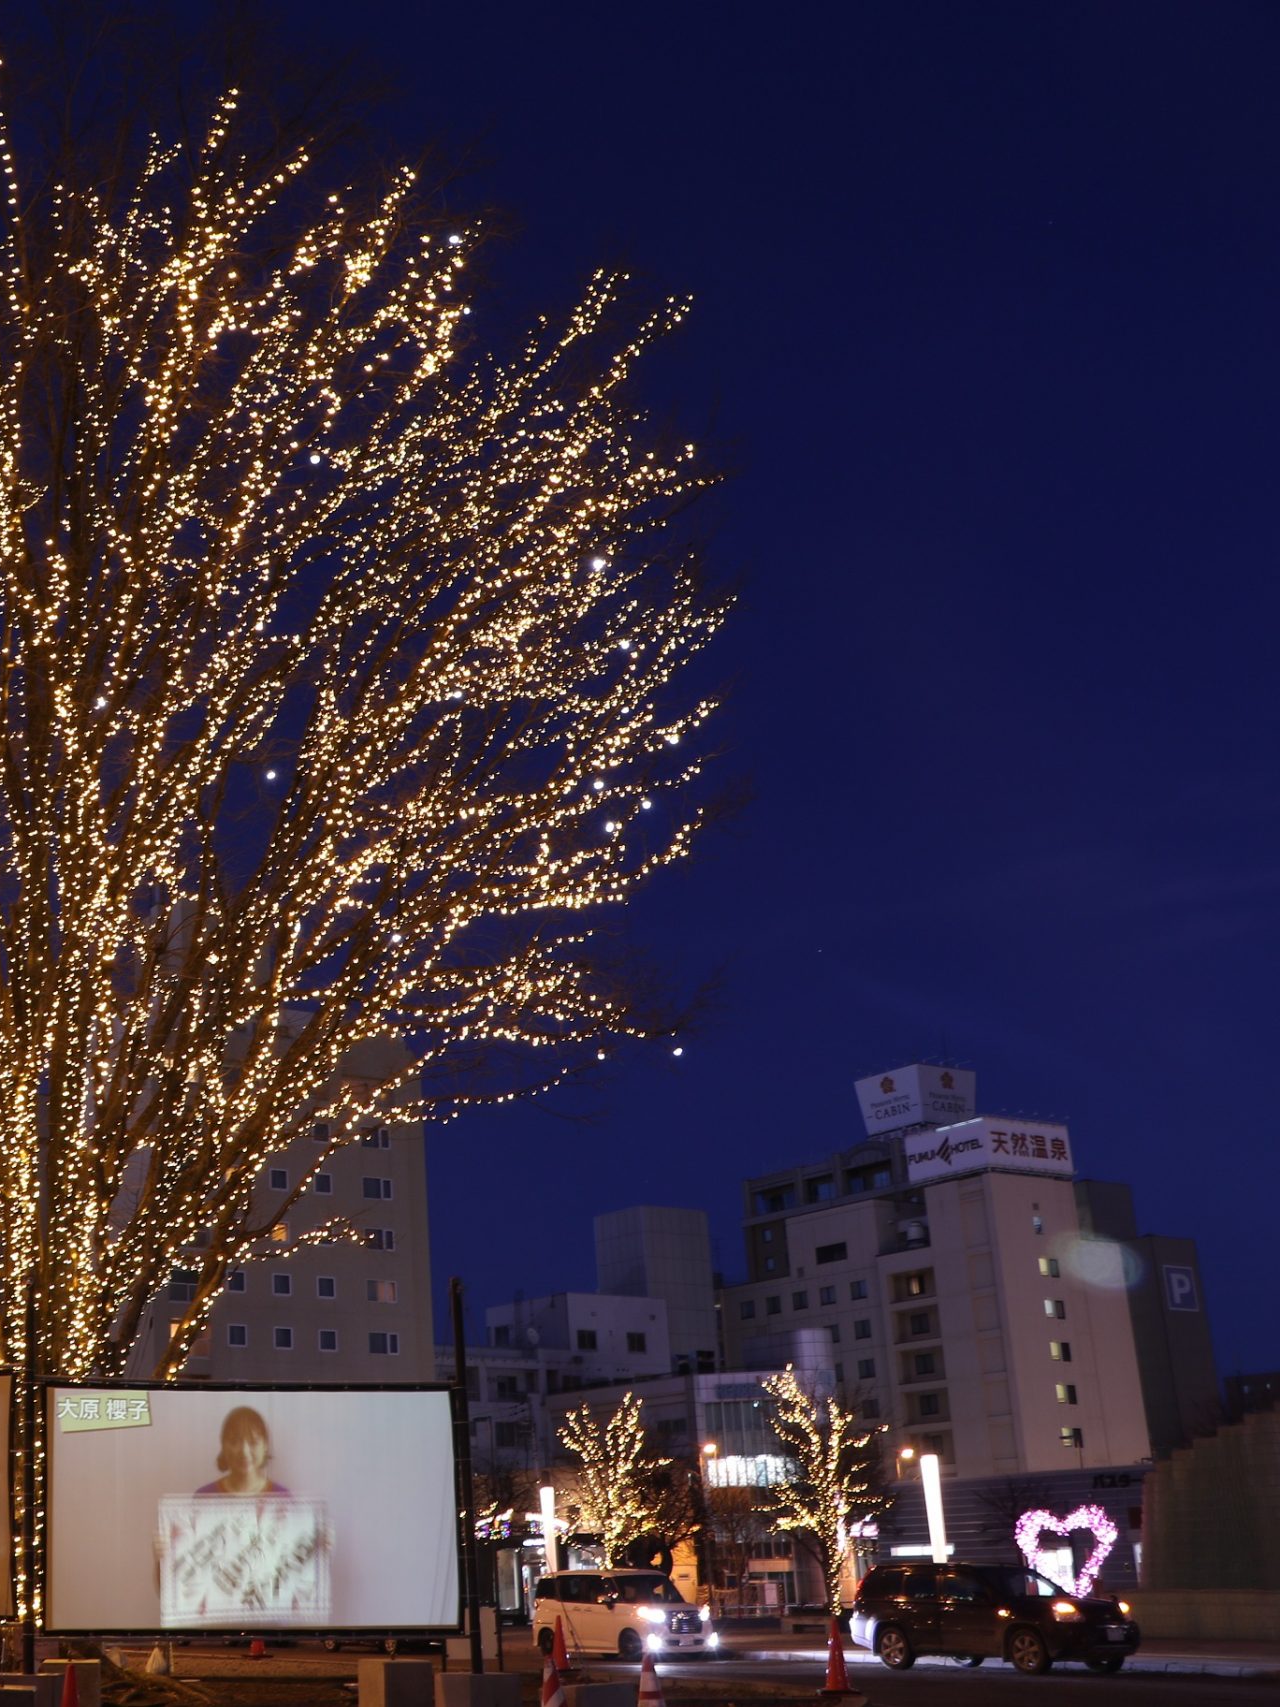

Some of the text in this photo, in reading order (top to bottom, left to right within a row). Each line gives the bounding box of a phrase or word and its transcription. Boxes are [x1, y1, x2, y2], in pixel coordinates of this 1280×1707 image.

[874, 1102, 912, 1120] CABIN
[932, 1100, 966, 1114] CABIN
[950, 1138, 984, 1155] HOTEL
[990, 1130, 1069, 1161] 天然温泉
[1169, 1272, 1191, 1304] P
[57, 1397, 149, 1420] 大原 櫻子
